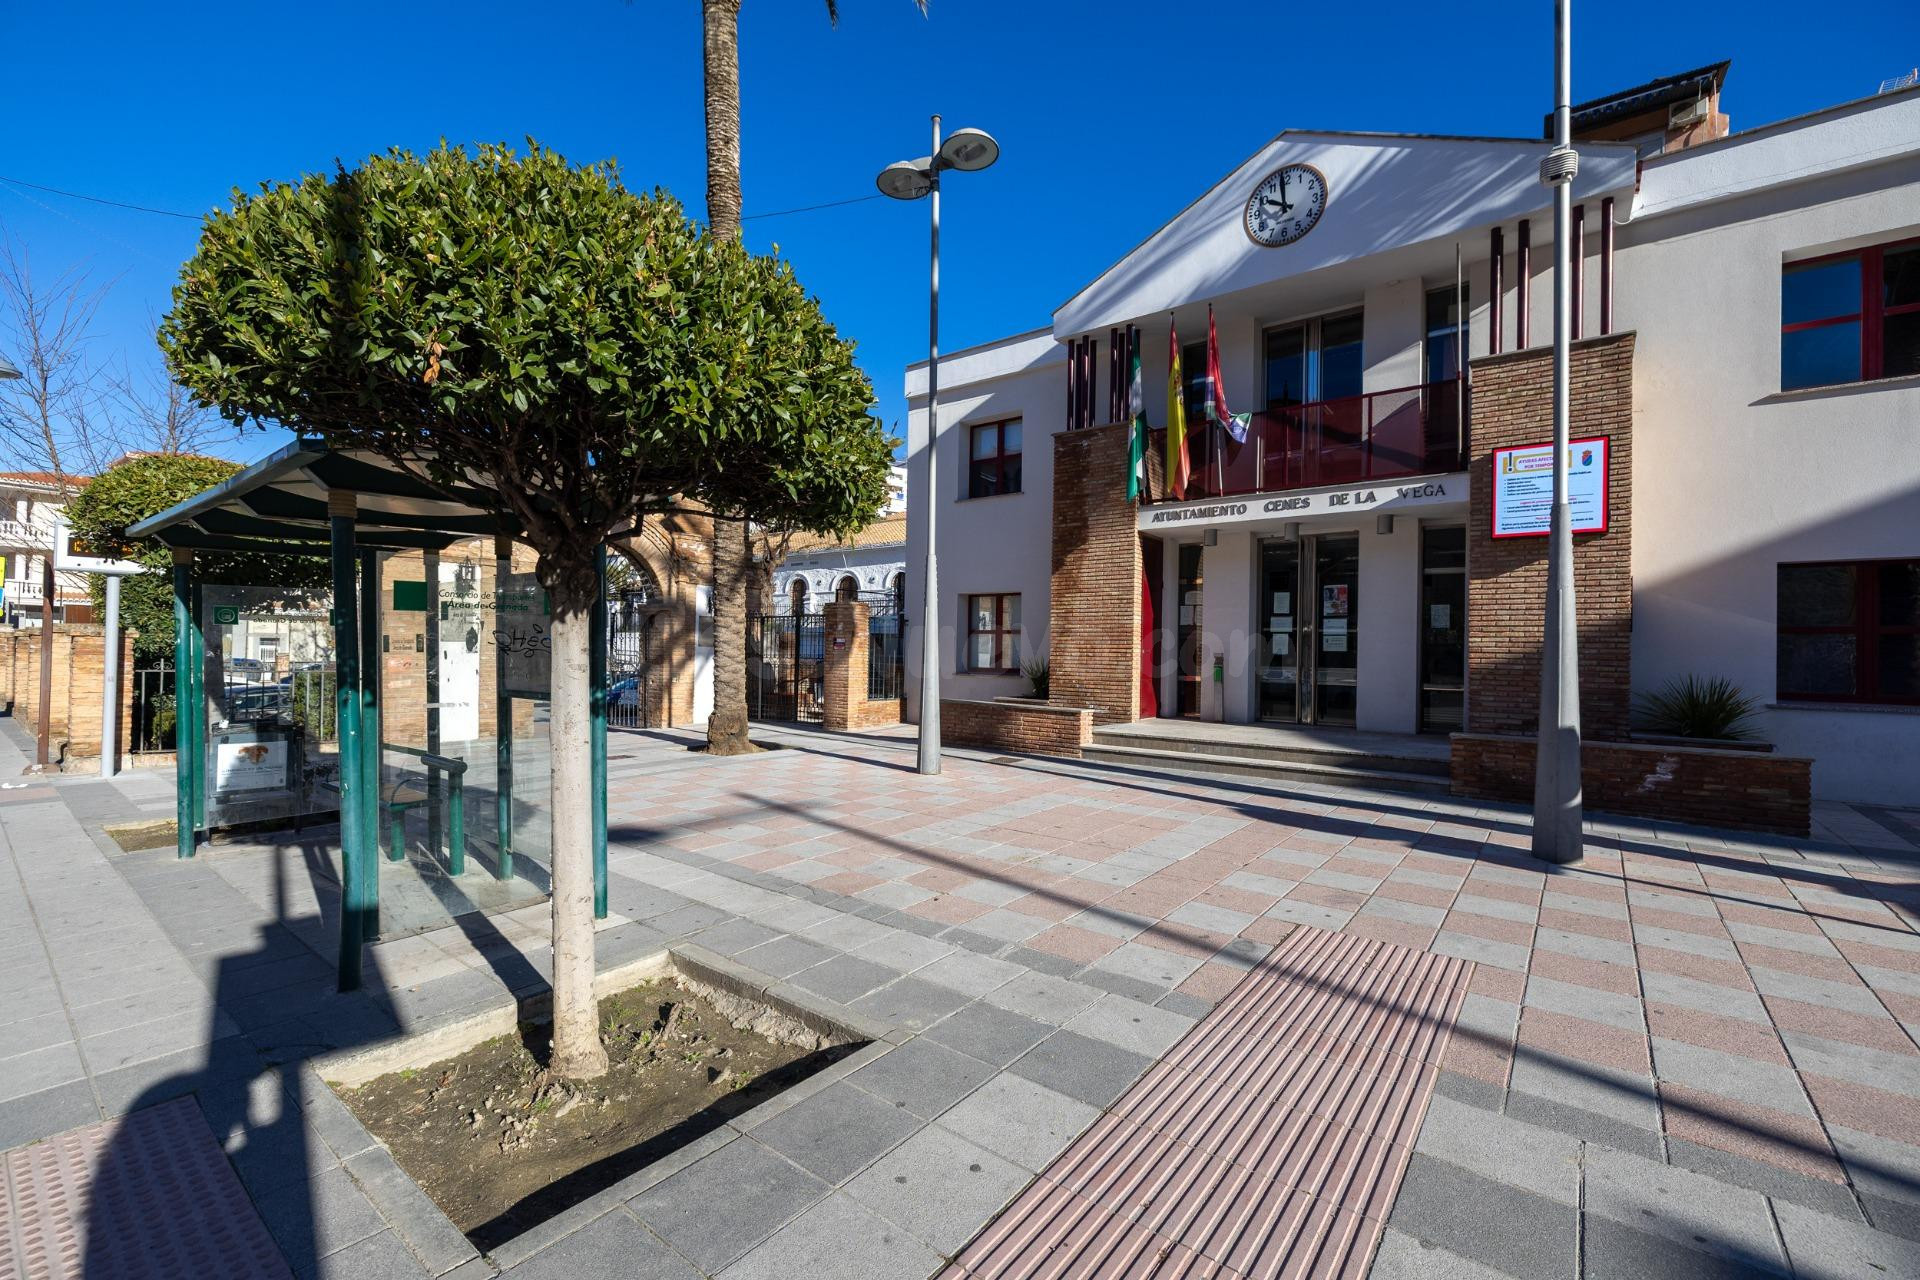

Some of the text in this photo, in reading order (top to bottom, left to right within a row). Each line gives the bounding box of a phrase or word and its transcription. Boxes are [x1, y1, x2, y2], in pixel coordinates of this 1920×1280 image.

[1308, 179, 1315, 190] 2
[1312, 193, 1319, 204] 3
[1253, 209, 1261, 220] 9
[1306, 208, 1313, 218] 4
[1258, 222, 1265, 232] 8
[1295, 220, 1301, 231] 5
[1269, 228, 1275, 239] 7
[1281, 227, 1288, 238] 6
[1151, 483, 1446, 523] AYUNTAMIENTO CENES DE LA VEGA
